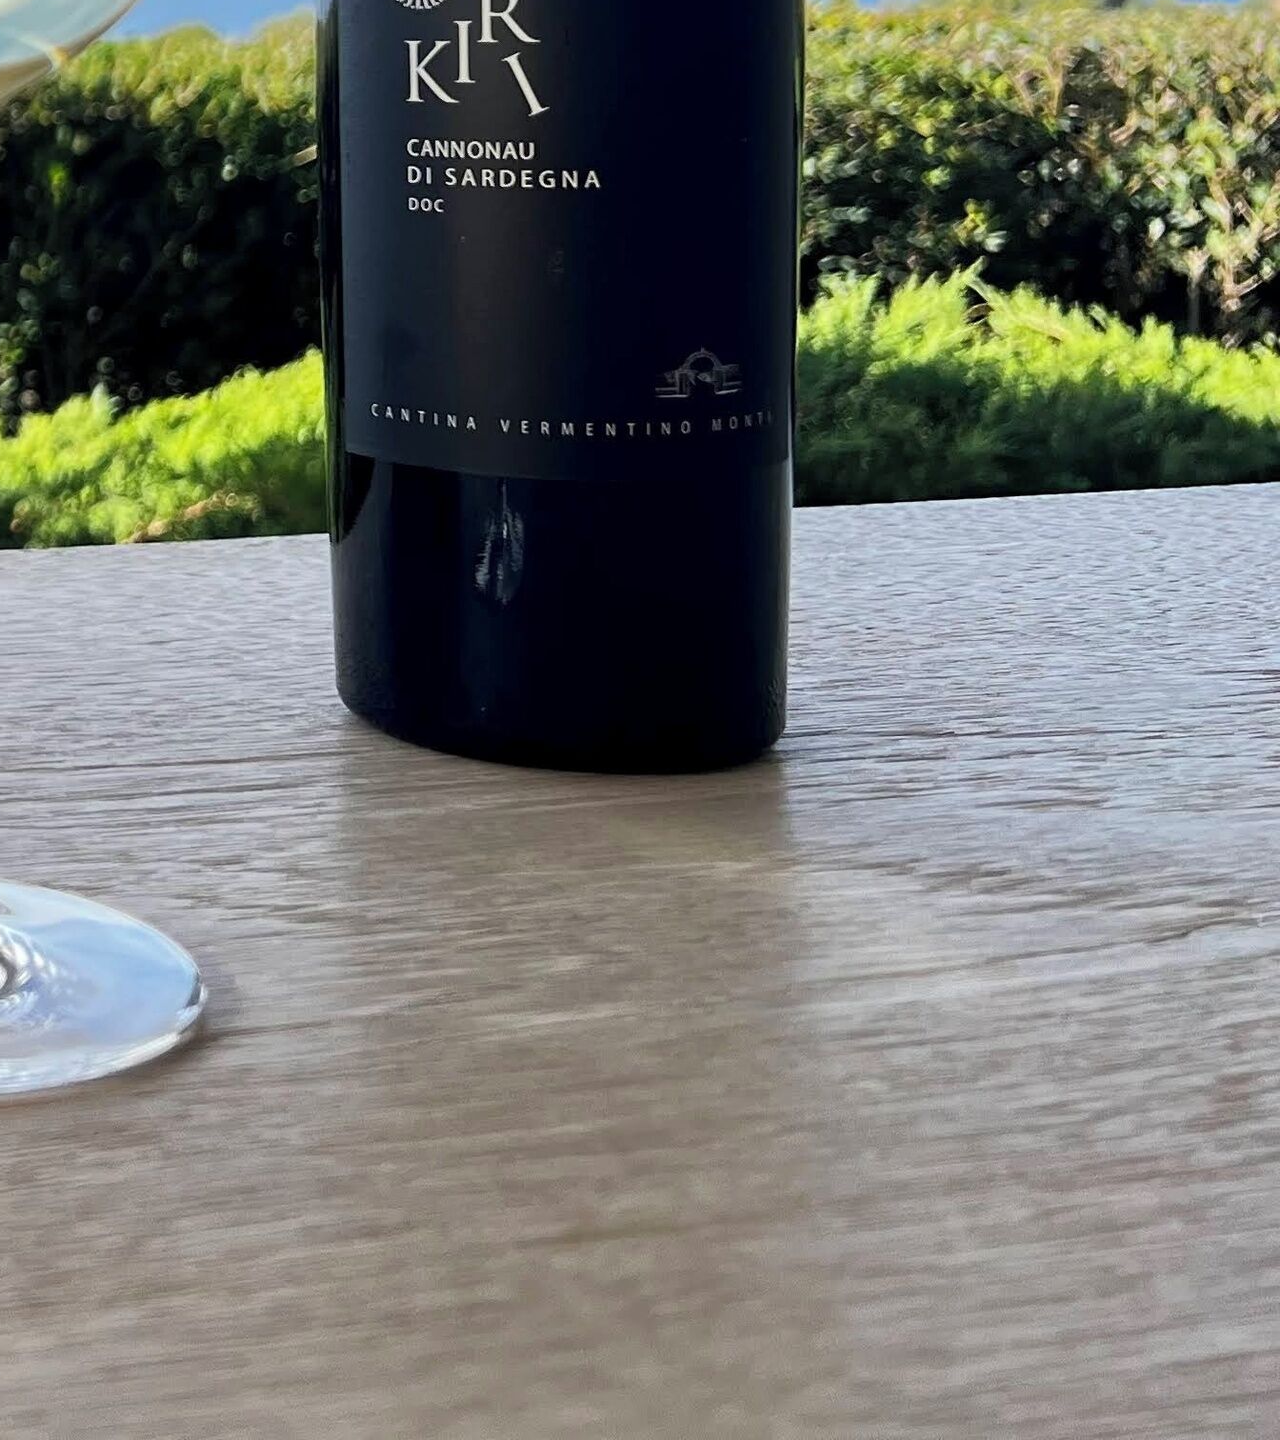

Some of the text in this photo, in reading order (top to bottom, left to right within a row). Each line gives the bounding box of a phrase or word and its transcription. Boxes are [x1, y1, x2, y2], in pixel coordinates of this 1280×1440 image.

[406, 138, 536, 160] CANNONAU
[406, 164, 602, 189] DI SARDEGNA
[407, 197, 445, 213] DOC
[370, 403, 477, 430] CANTINA
[499, 418, 692, 436] VERMENTINO
